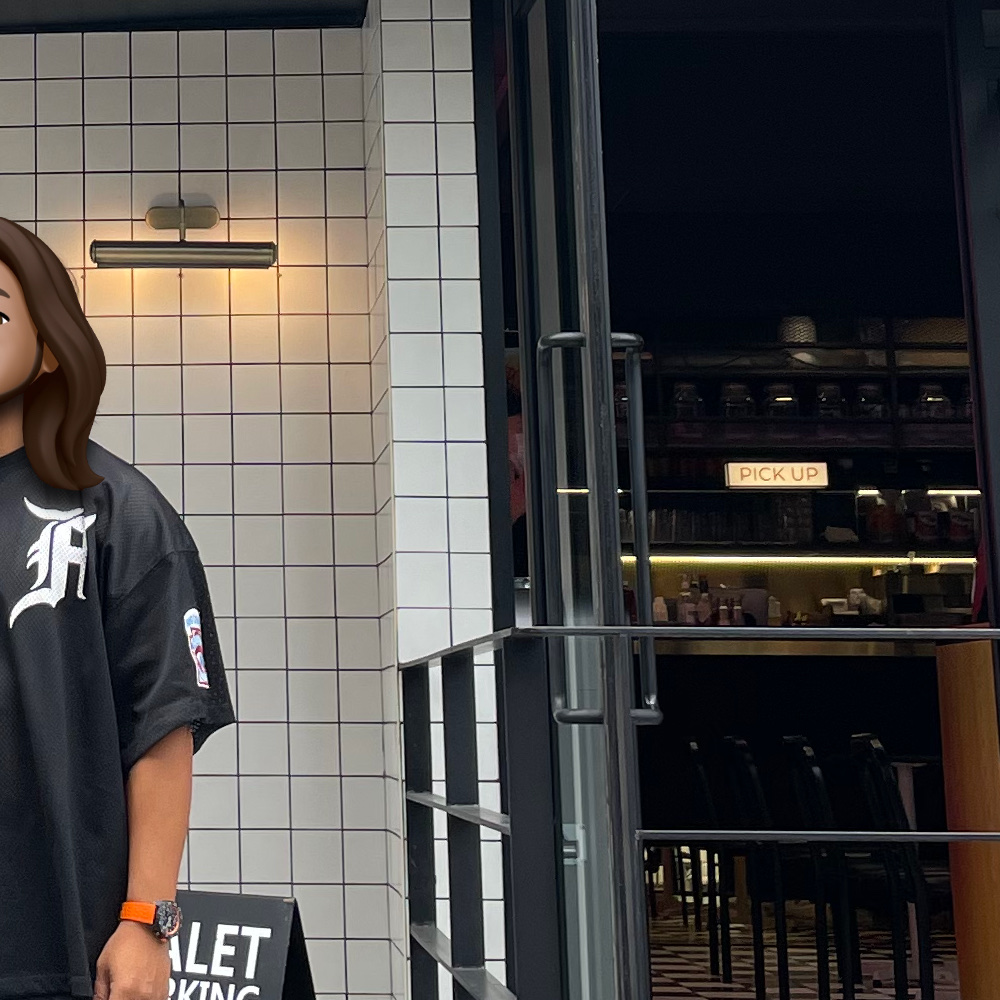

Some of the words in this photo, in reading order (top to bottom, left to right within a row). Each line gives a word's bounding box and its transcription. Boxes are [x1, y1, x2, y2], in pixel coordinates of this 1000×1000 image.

[739, 466, 786, 482] PICK
[791, 466, 819, 482] UP
[168, 921, 272, 980] ALET
